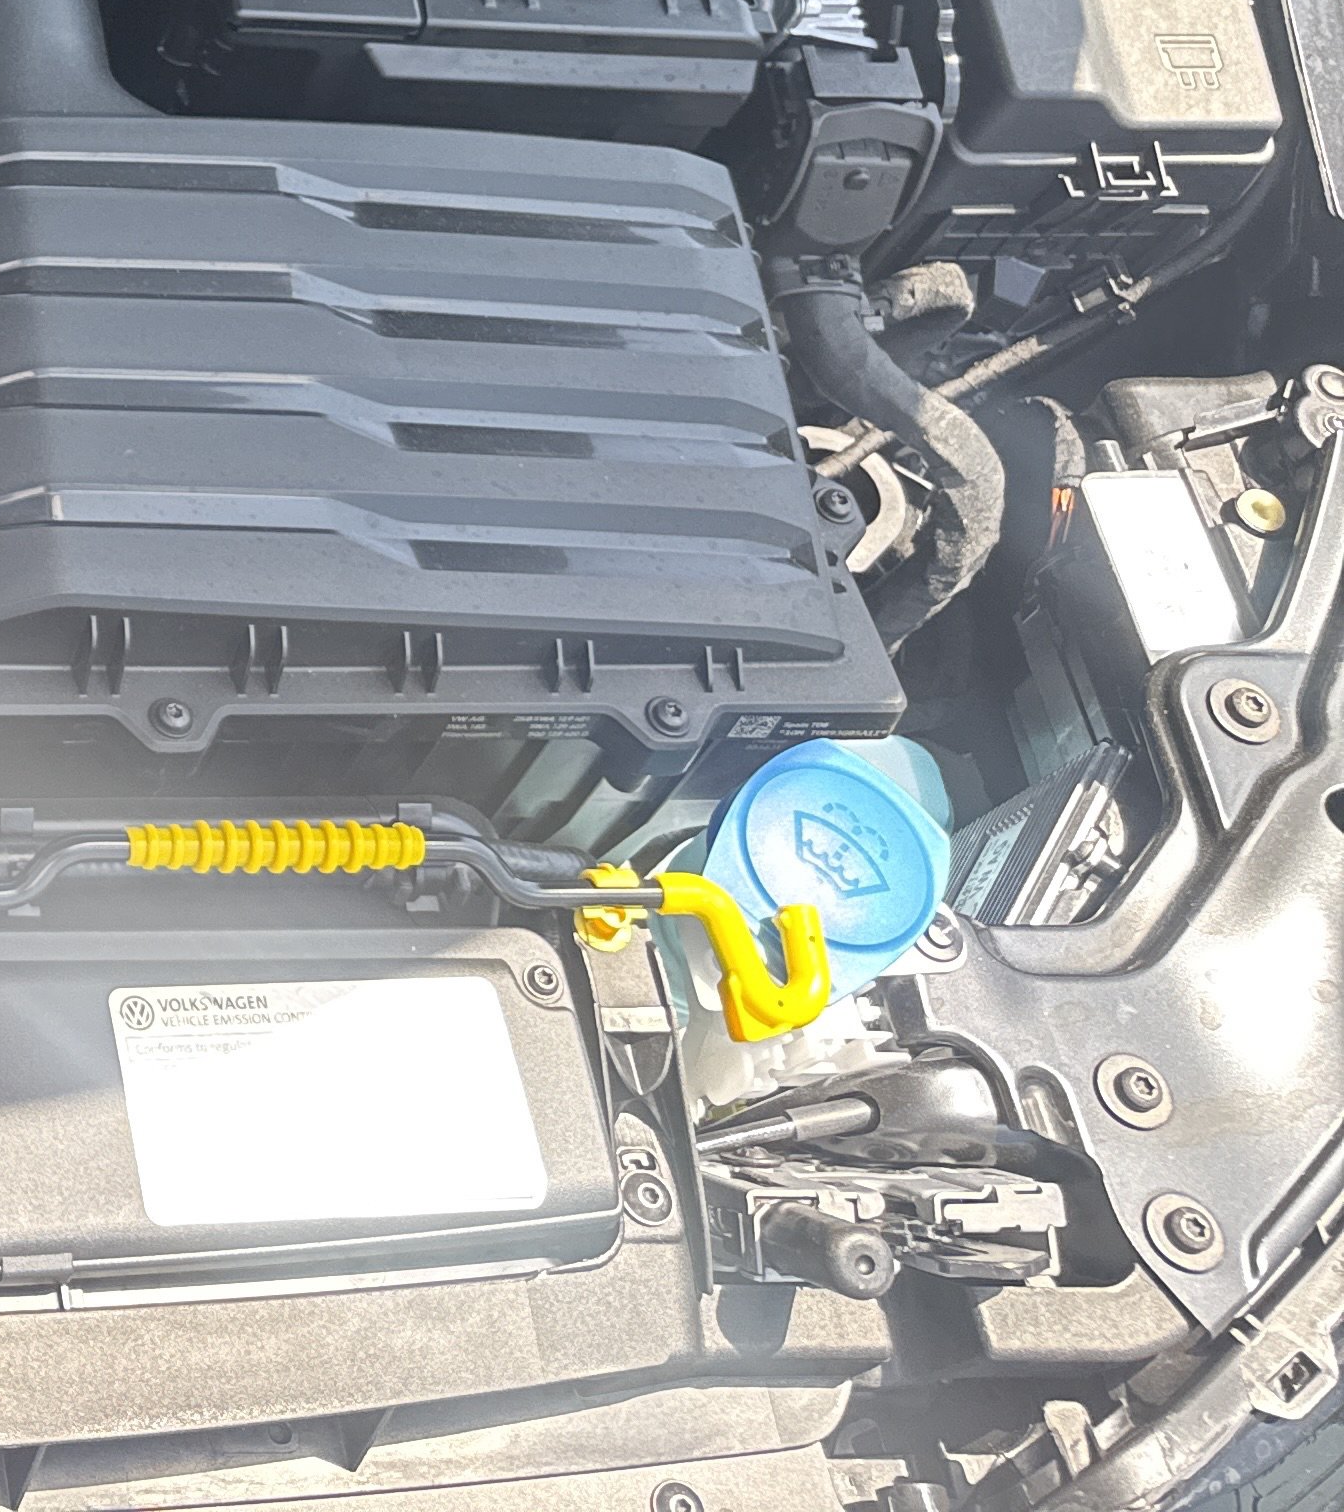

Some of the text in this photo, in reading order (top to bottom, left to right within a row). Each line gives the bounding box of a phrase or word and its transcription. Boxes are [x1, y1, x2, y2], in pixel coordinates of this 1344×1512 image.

[157, 995, 268, 1012] VOLKSWAGEN
[161, 1011, 312, 1028] VEHICLE EMISSION CONT
